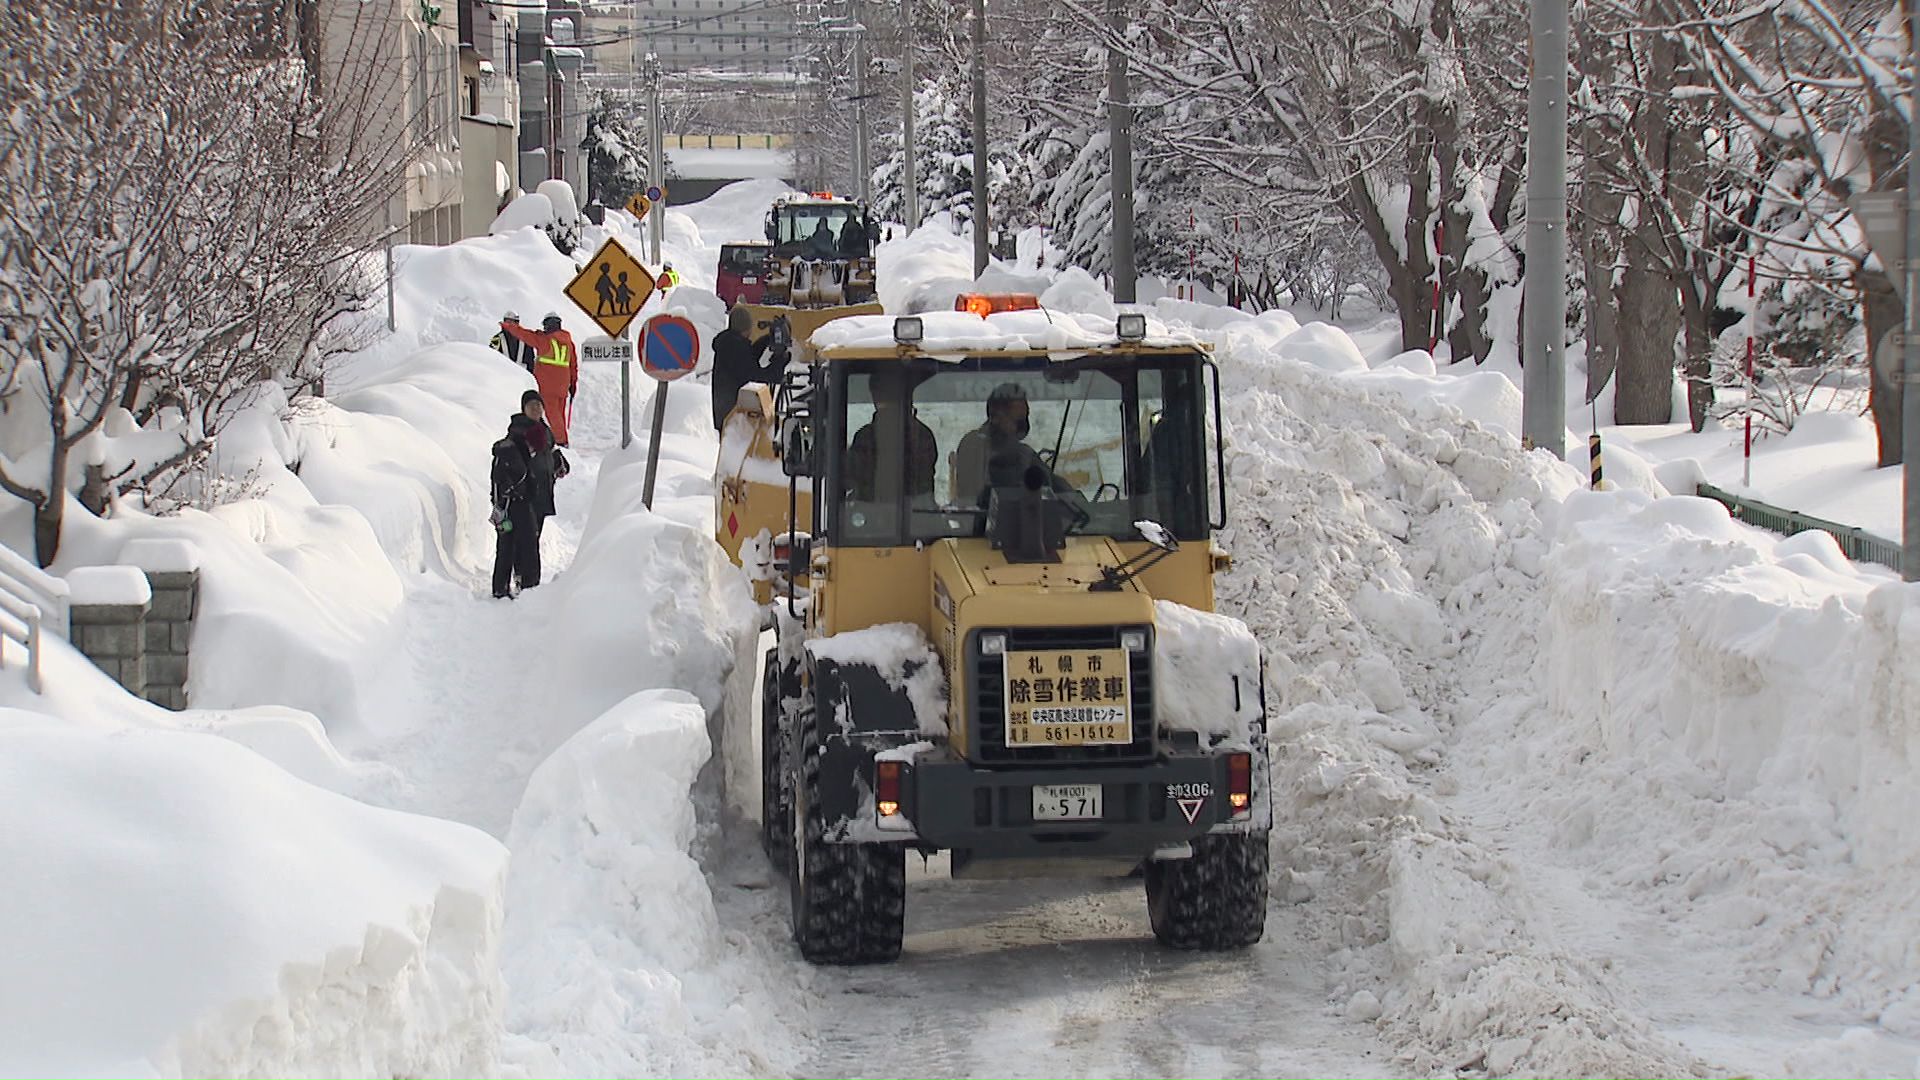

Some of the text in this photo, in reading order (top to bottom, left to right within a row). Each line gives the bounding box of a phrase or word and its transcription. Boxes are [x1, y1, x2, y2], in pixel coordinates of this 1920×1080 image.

[1028, 655, 1101, 674] 札幌市
[1010, 676, 1124, 704] 除雪作業車
[1046, 725, 1114, 740] 561-1512
